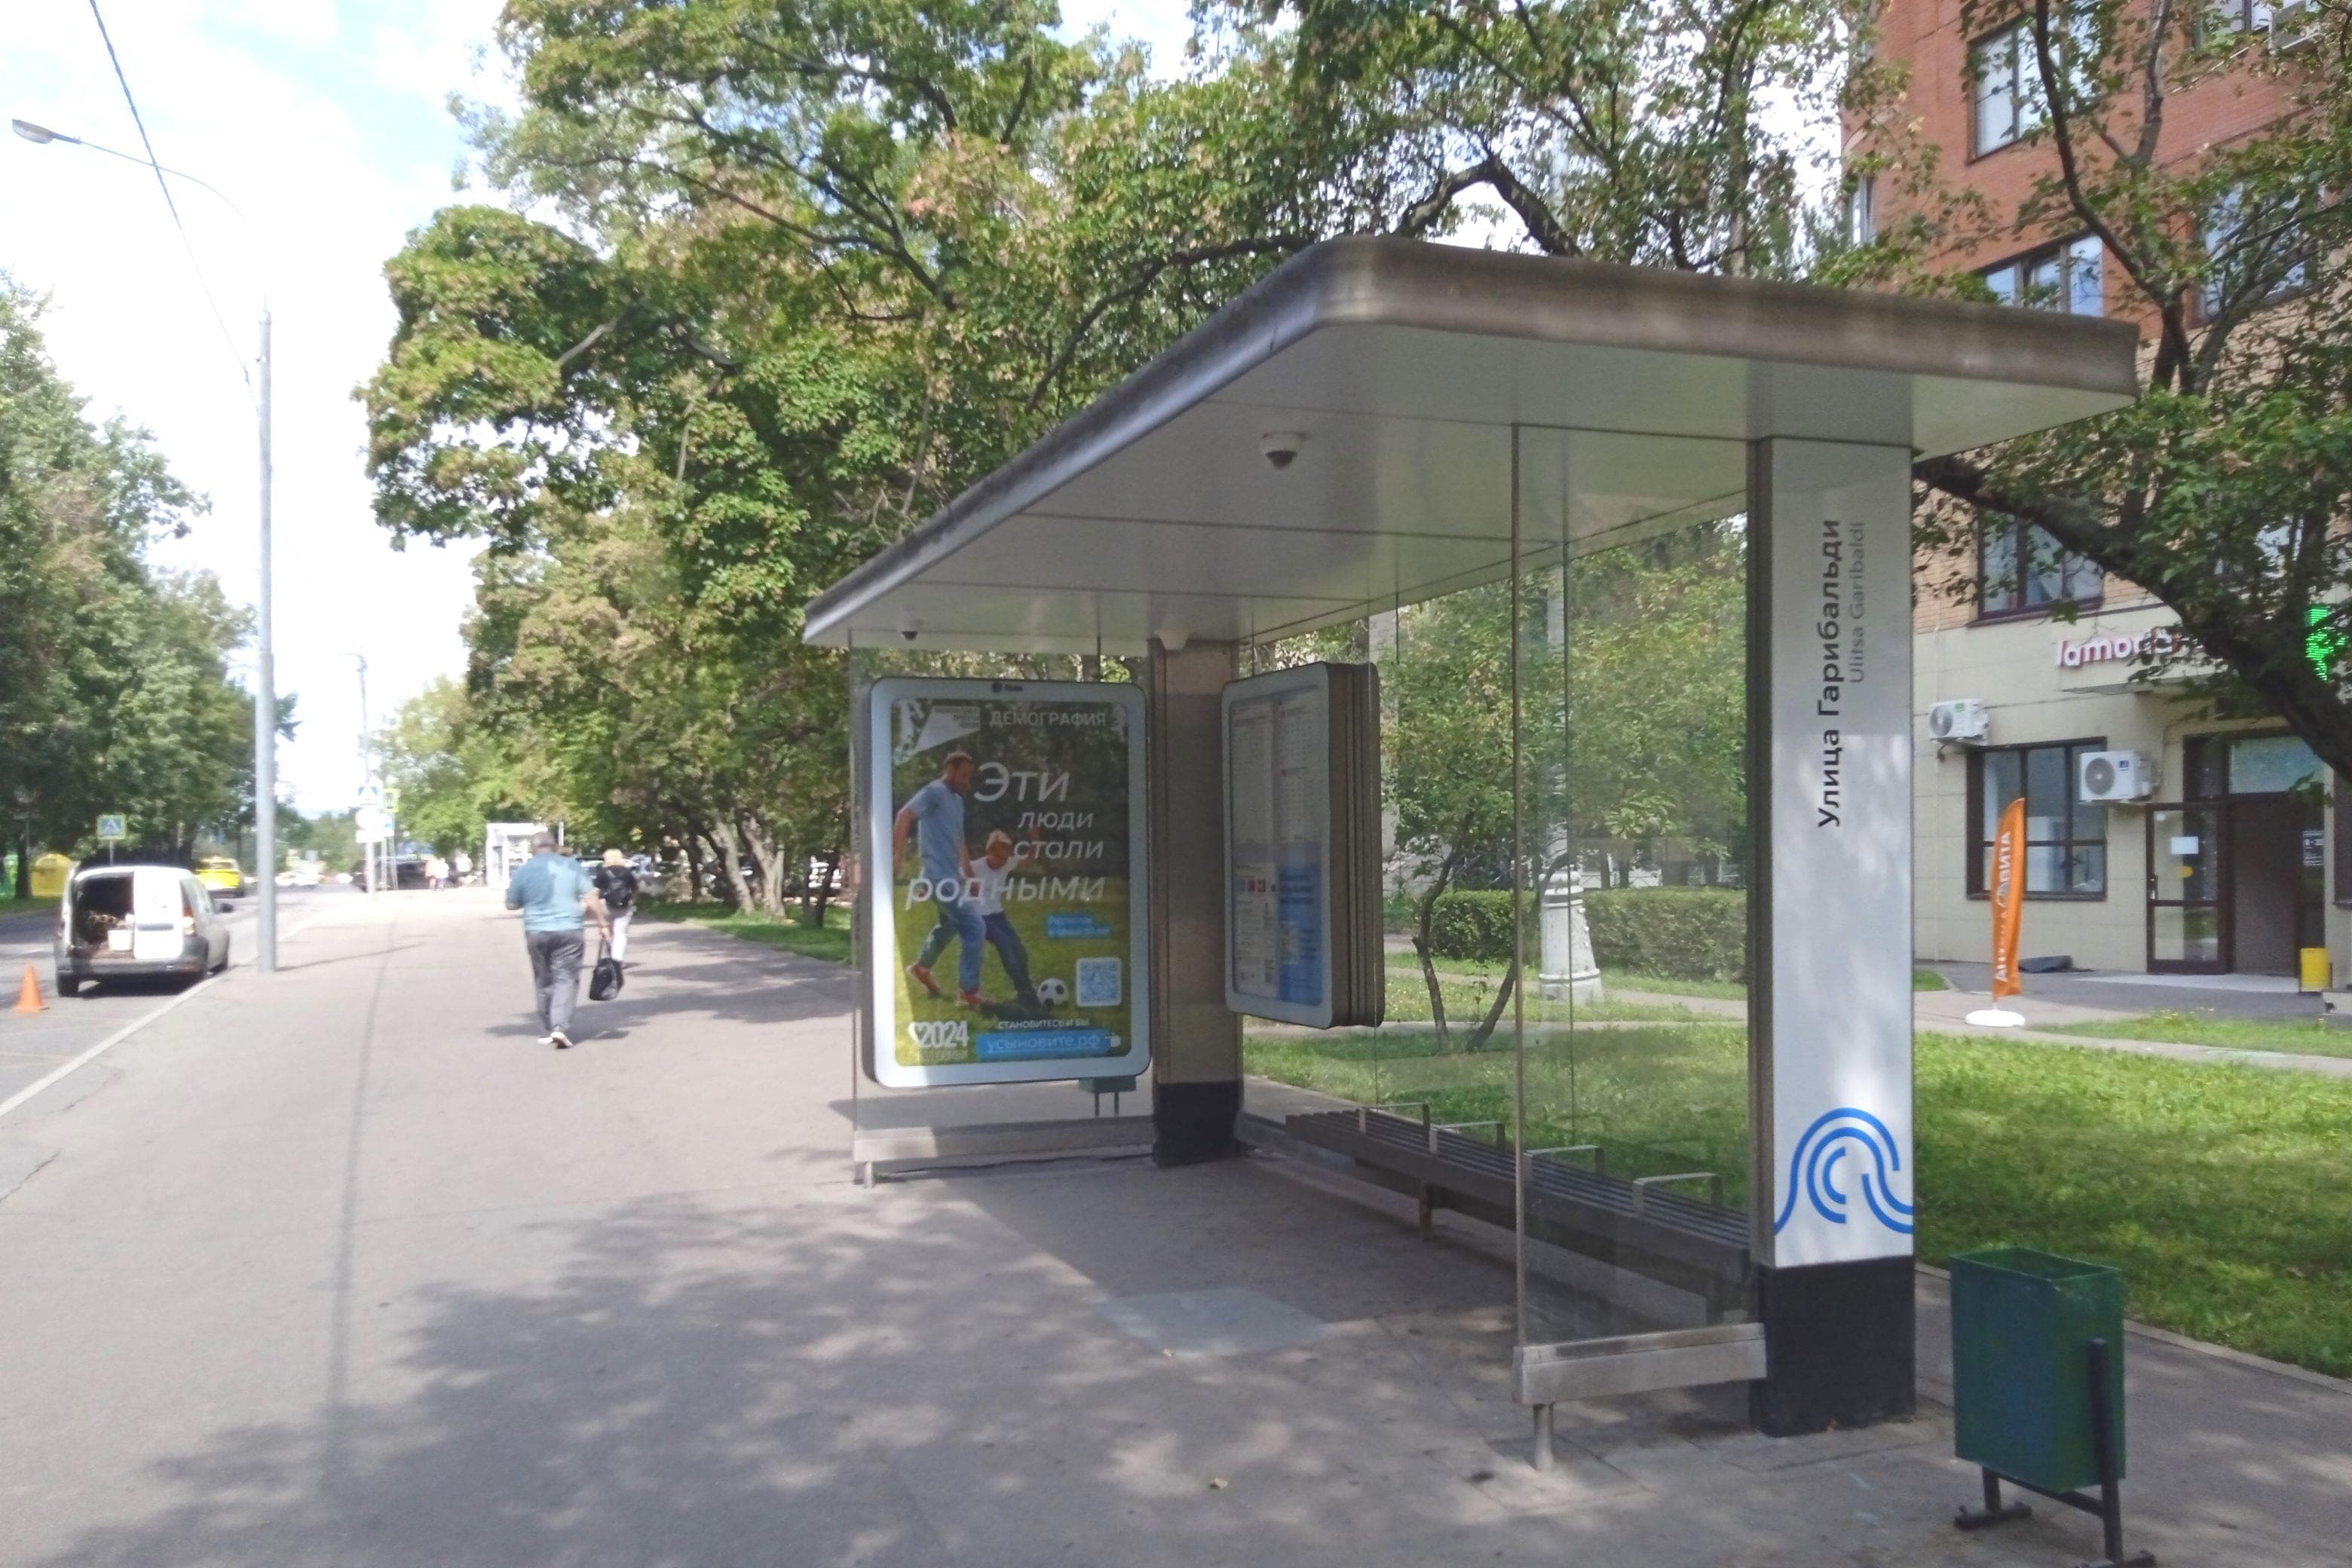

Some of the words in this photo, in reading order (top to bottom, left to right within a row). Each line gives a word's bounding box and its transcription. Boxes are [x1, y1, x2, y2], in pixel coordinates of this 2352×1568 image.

[1848, 522, 1865, 620] Garibaldi
[1817, 520, 1845, 716] Гарибальди
[1849, 627, 1865, 683] Ulitsa
[989, 711, 1107, 728] ДЕМОГРАФИЯ
[974, 761, 1070, 803] Эти
[1818, 730, 1843, 828] Улица
[1018, 811, 1094, 831] люди
[1014, 841, 1104, 859] стали
[906, 876, 1106, 909] родными
[920, 1020, 969, 1048] 2024
